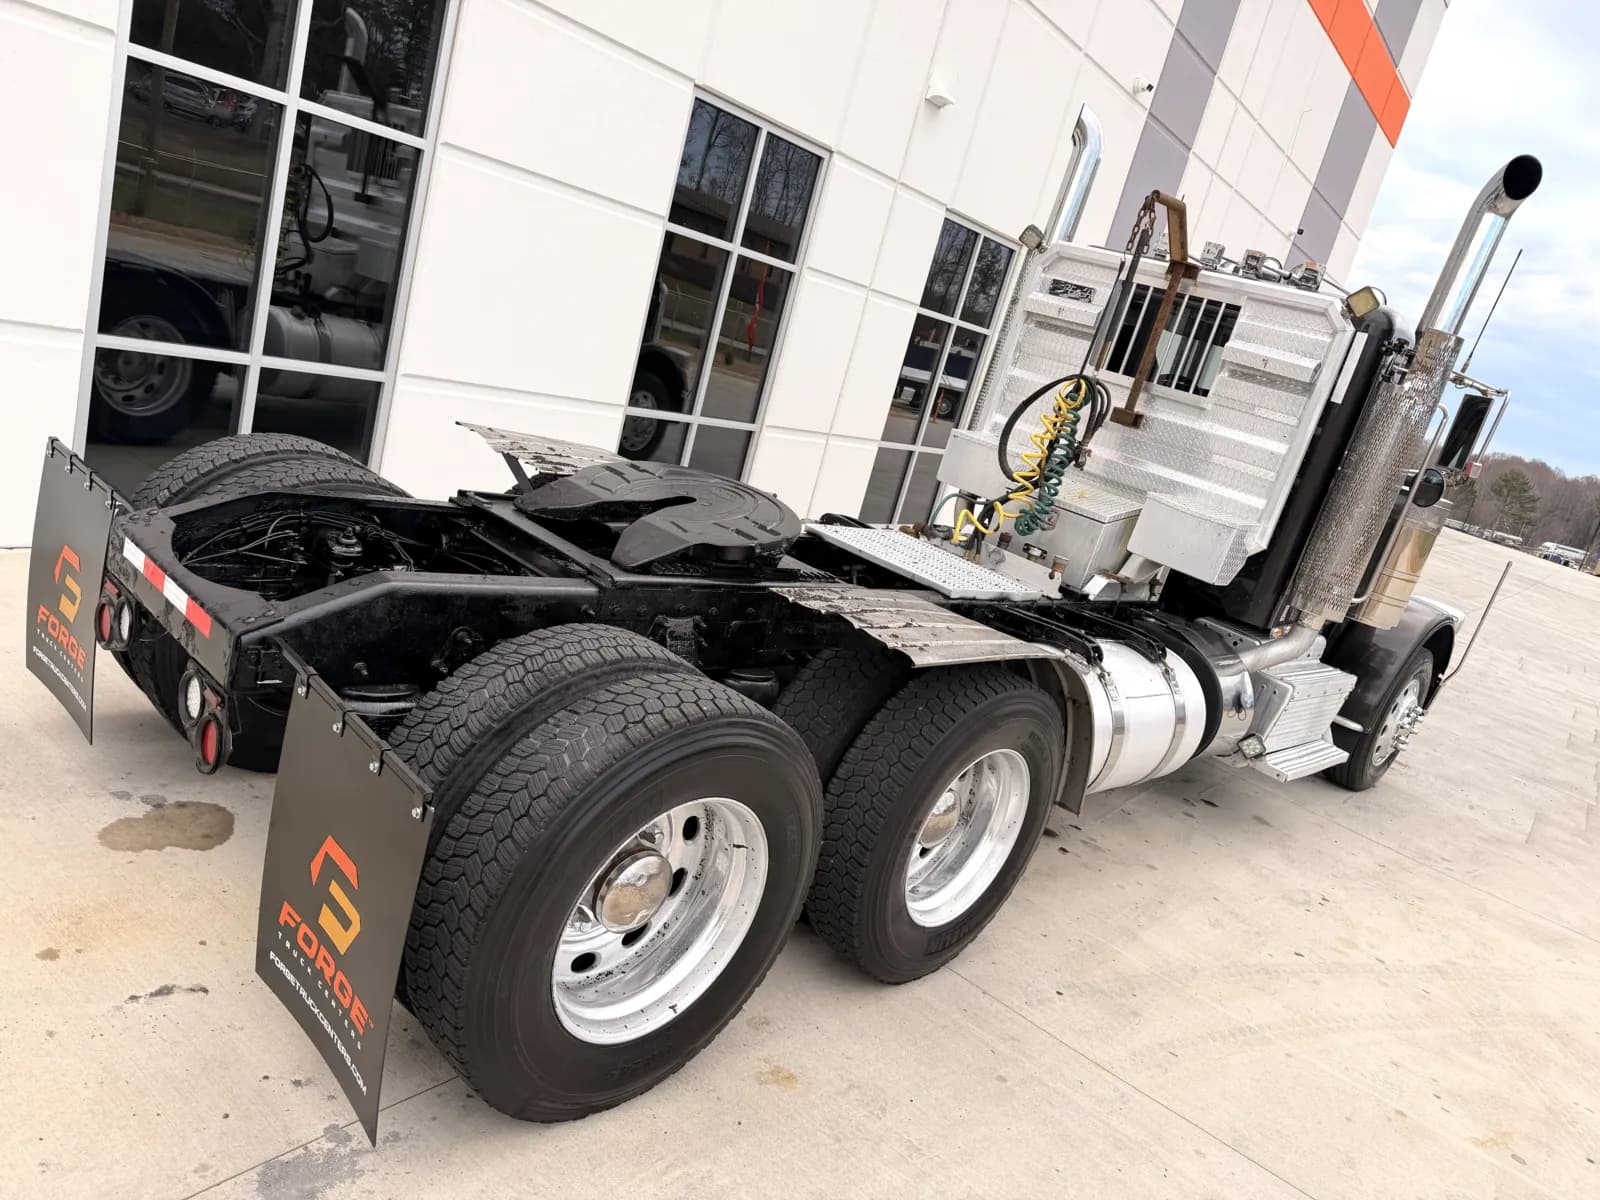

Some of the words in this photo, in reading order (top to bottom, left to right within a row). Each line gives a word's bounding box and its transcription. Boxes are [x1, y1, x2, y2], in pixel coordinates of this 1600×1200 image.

[37, 604, 87, 672] FORGE
[269, 950, 367, 1096] FORGETRUCKCENTERS.COM
[277, 931, 312, 976] TRUCK
[317, 980, 361, 1050] CENTERS
[278, 900, 369, 1036] FORGE
